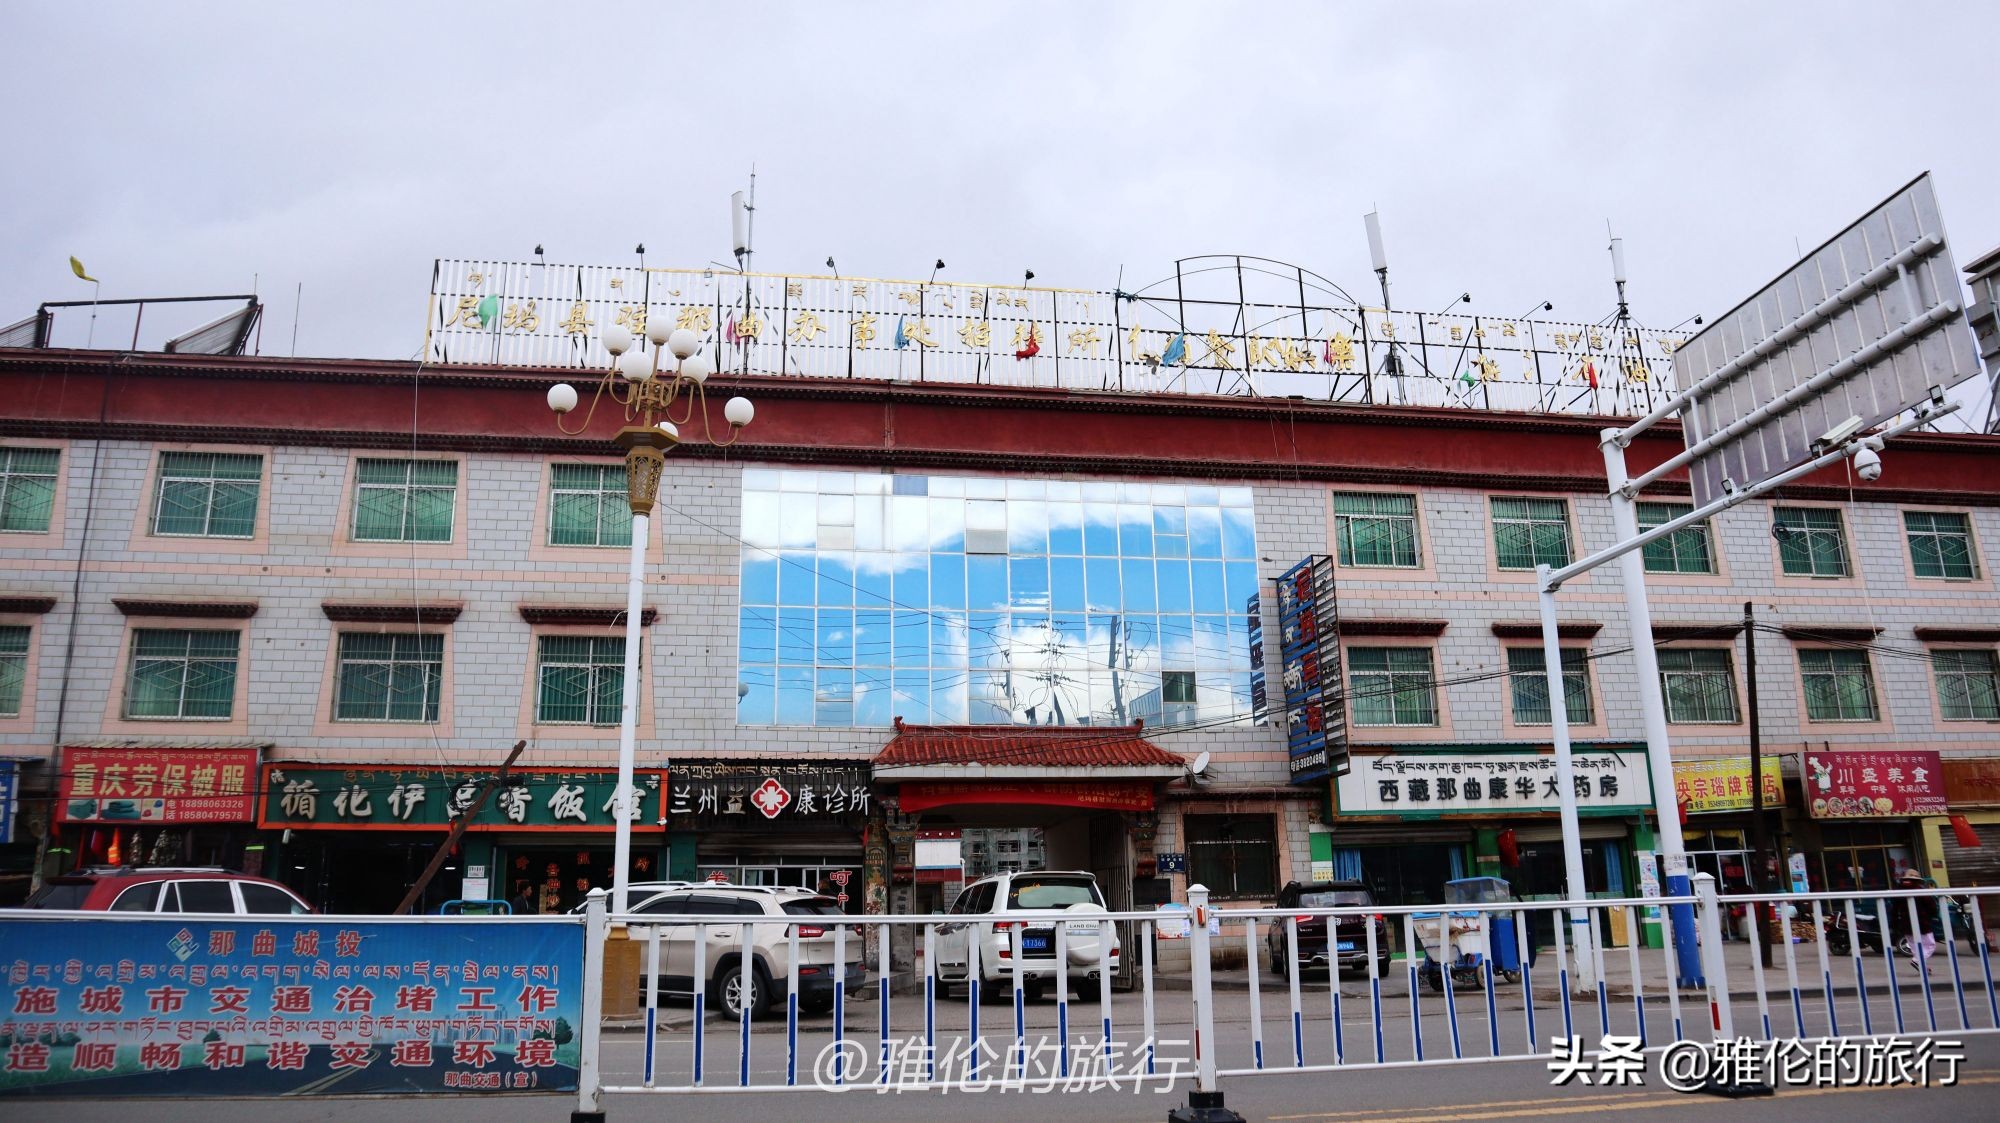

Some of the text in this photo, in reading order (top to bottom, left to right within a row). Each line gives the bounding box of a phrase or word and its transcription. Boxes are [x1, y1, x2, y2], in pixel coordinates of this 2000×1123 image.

[69, 763, 246, 797] 重庆劳保被服
[1378, 774, 1619, 802] 西藏那曲康华大药房
[1837, 767, 1929, 784] 川盛美食
[166, 800, 176, 820] 电话
[670, 783, 872, 816] 兰州益康诊所
[1169, 861, 1175, 869] 9
[209, 930, 361, 957] 那曲城投
[14, 985, 558, 1014] 施城市交通治堵工作
[5, 1040, 557, 1070] 造顺畅和谐交通环境
